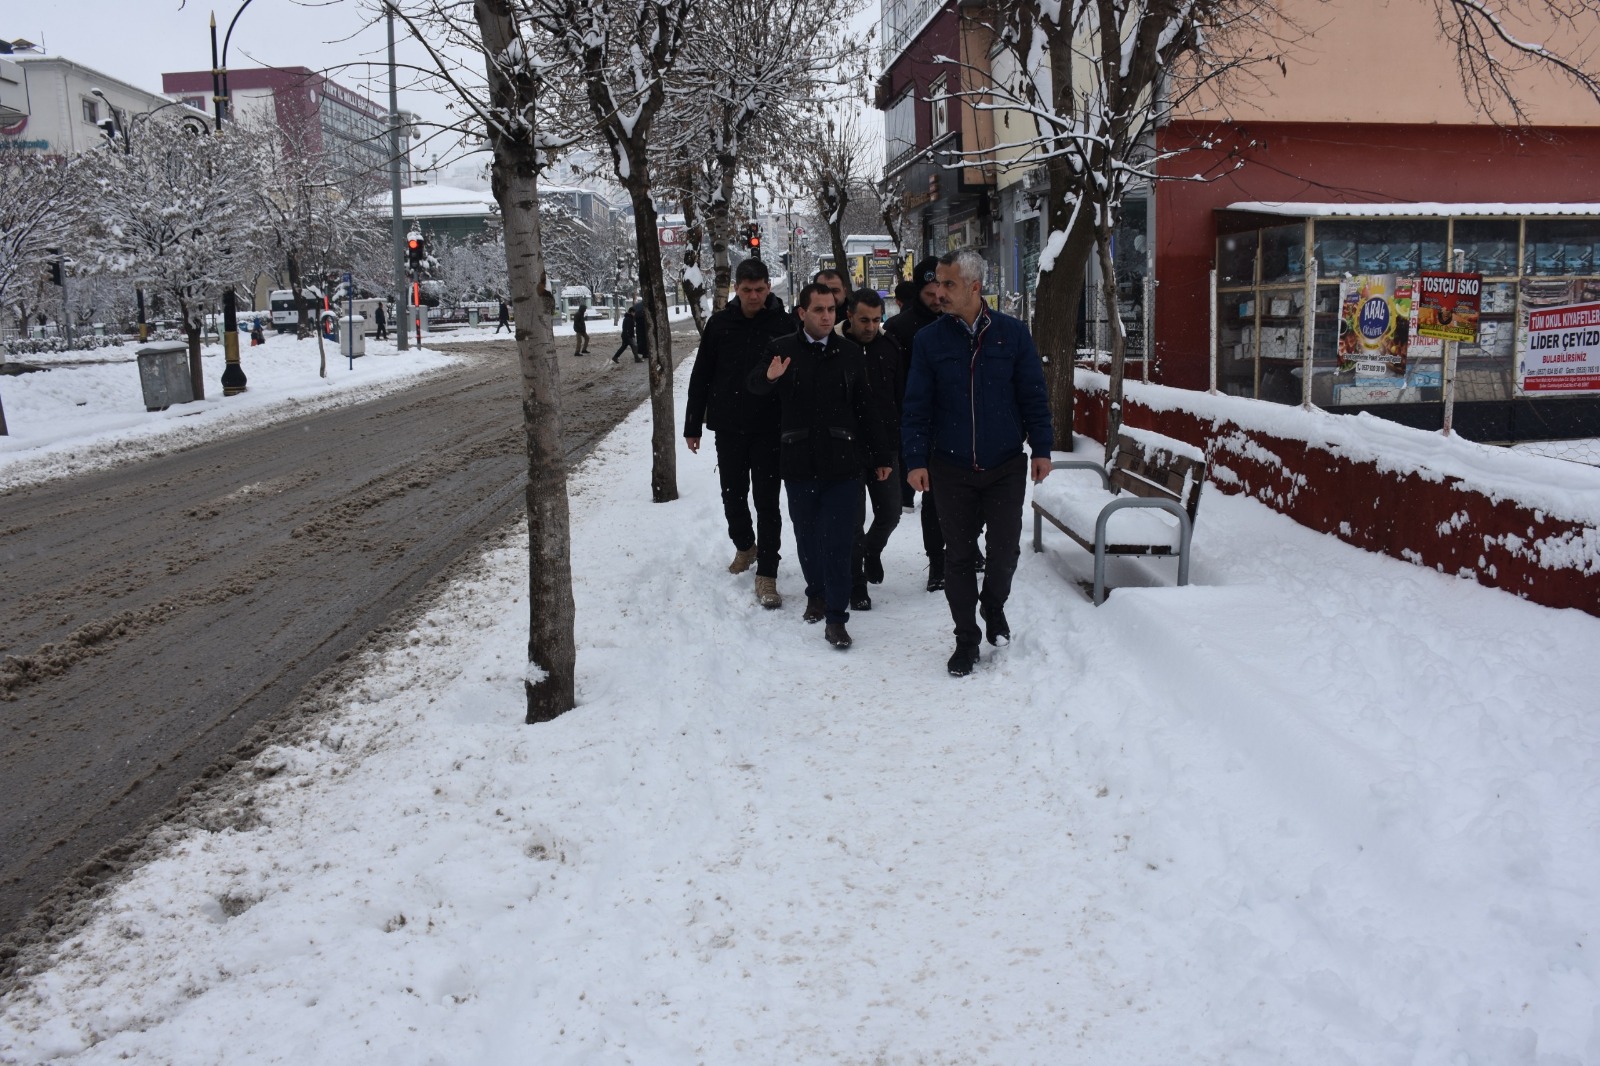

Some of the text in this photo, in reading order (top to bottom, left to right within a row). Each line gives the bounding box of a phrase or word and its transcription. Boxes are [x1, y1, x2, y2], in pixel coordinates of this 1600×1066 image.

[1422, 277, 1456, 297] TOSTÇU
[1364, 300, 1385, 320] KRAL
[1531, 313, 1544, 329] TÜM
[1545, 313, 1561, 327] OKUL
[1531, 332, 1559, 350] LİDER
